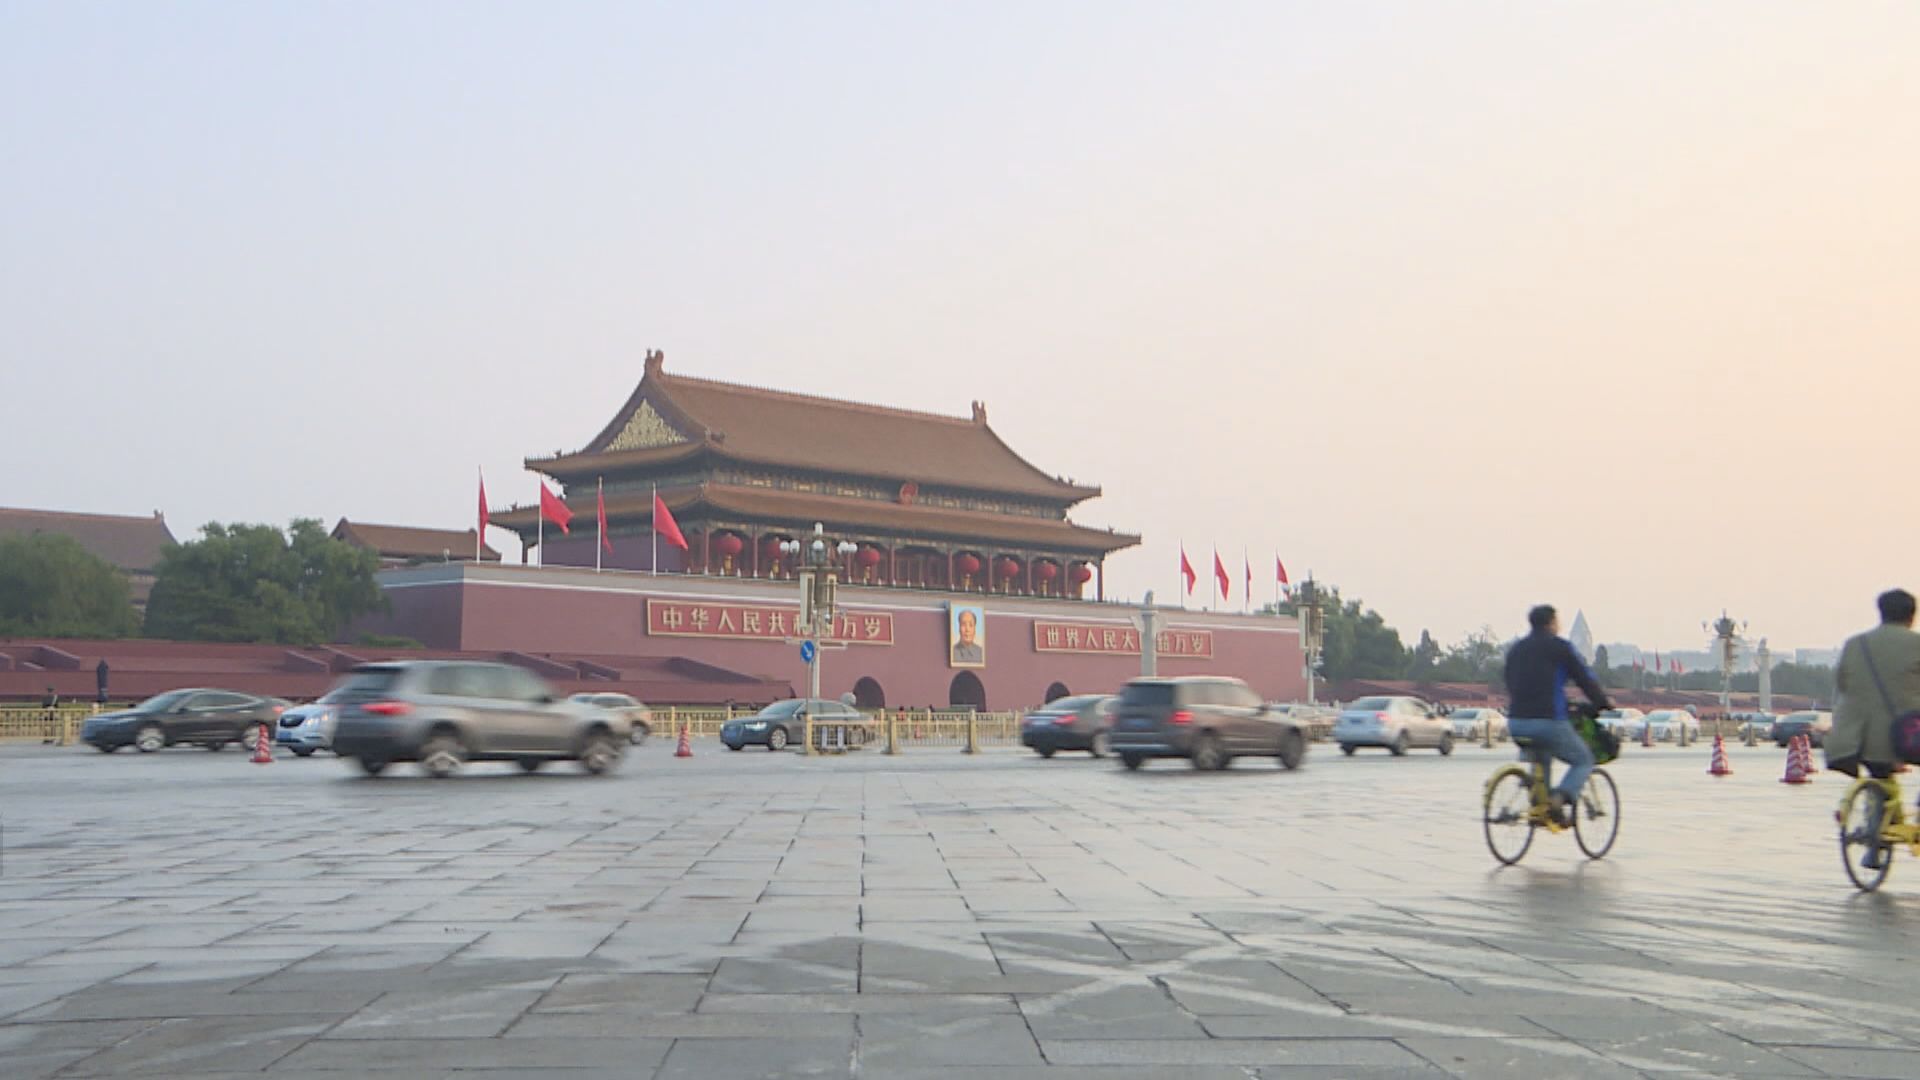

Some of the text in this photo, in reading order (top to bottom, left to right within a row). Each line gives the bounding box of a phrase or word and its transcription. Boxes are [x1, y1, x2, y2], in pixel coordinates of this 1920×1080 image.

[1047, 628, 1203, 653] 世界人民大结万岁
